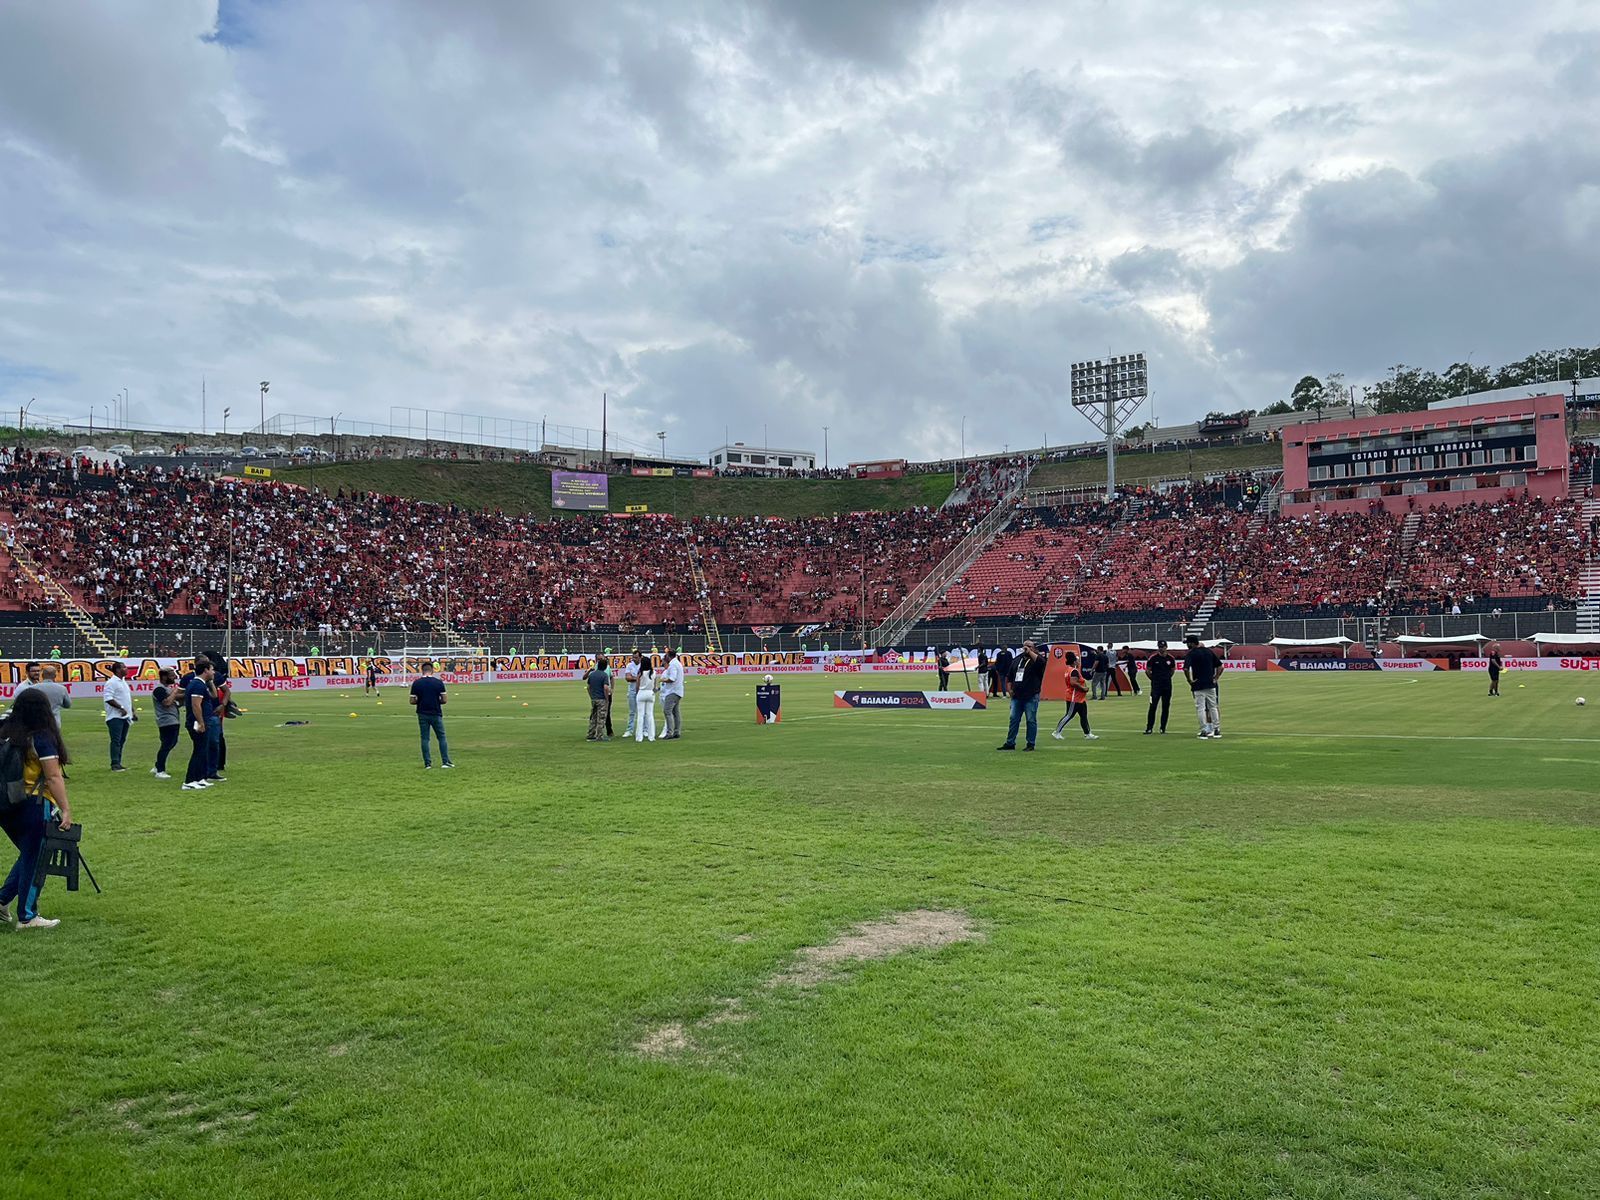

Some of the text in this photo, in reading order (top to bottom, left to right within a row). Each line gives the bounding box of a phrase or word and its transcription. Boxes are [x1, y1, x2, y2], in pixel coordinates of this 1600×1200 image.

[1394, 446, 1428, 456] MANOEL
[1434, 441, 1483, 453] BARRADAS
[743, 651, 805, 666] NOME
[823, 663, 862, 673] SUPERBET
[1300, 661, 1375, 670] BAIANÃO 2024
[1382, 661, 1424, 669] SUPERBET
[1505, 659, 1538, 668] BÔNUS
[250, 676, 310, 691] SUPERBET
[326, 676, 355, 686] RECEBA
[861, 696, 924, 705] BAIANÃO 2024
[930, 696, 965, 704] SUPERBET
